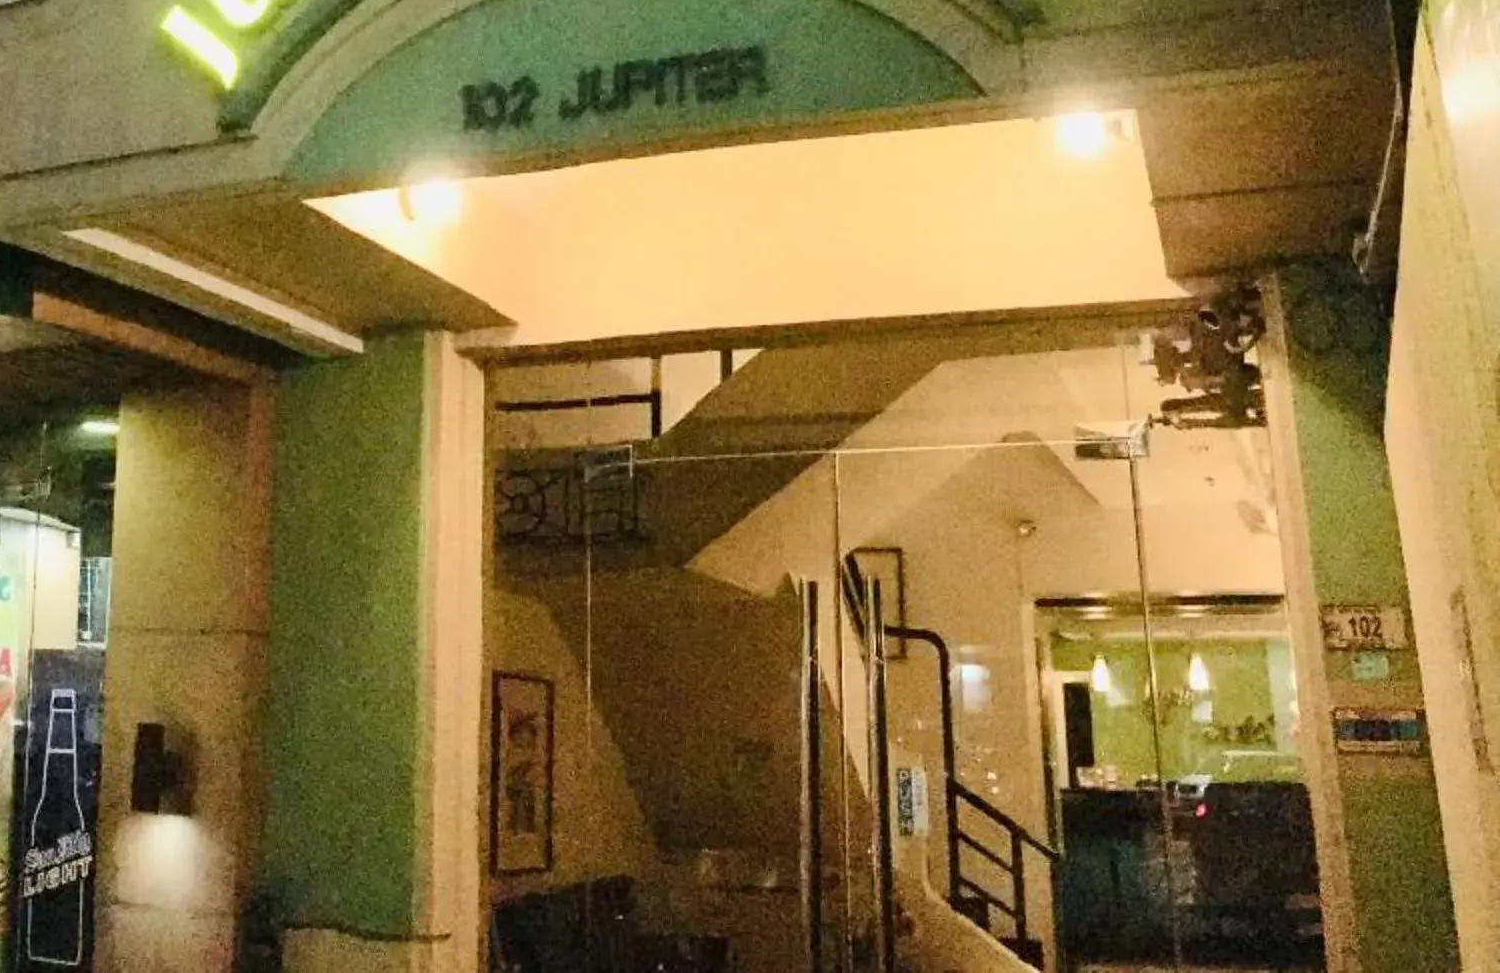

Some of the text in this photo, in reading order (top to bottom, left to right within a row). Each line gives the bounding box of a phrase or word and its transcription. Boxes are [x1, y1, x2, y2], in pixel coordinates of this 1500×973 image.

[461, 45, 768, 131] 102 JUPITER
[1348, 615, 1383, 638] 102
[899, 770, 914, 832] PUSH
[23, 855, 93, 897] LIGHT
